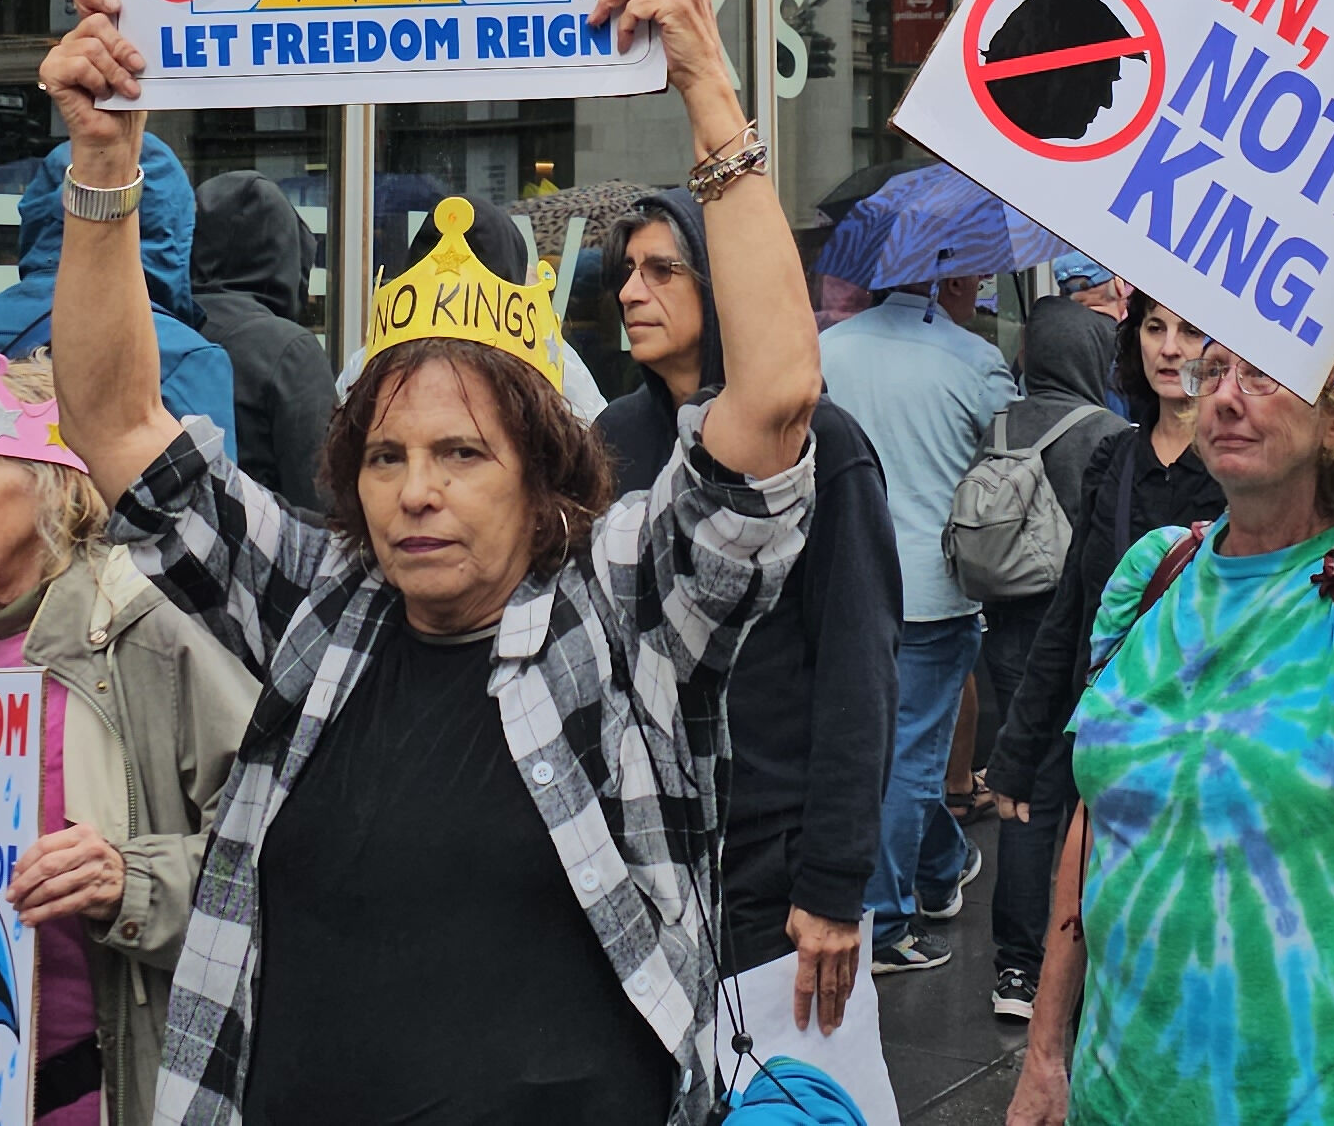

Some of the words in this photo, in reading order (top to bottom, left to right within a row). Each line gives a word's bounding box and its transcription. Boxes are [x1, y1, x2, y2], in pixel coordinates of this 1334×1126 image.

[160, 24, 238, 68] LET
[252, 17, 459, 66] FREEDOM
[476, 14, 612, 60] REIGN
[1107, 116, 1330, 347] KING.
[372, 284, 418, 345] NO
[431, 282, 537, 350] KINGS
